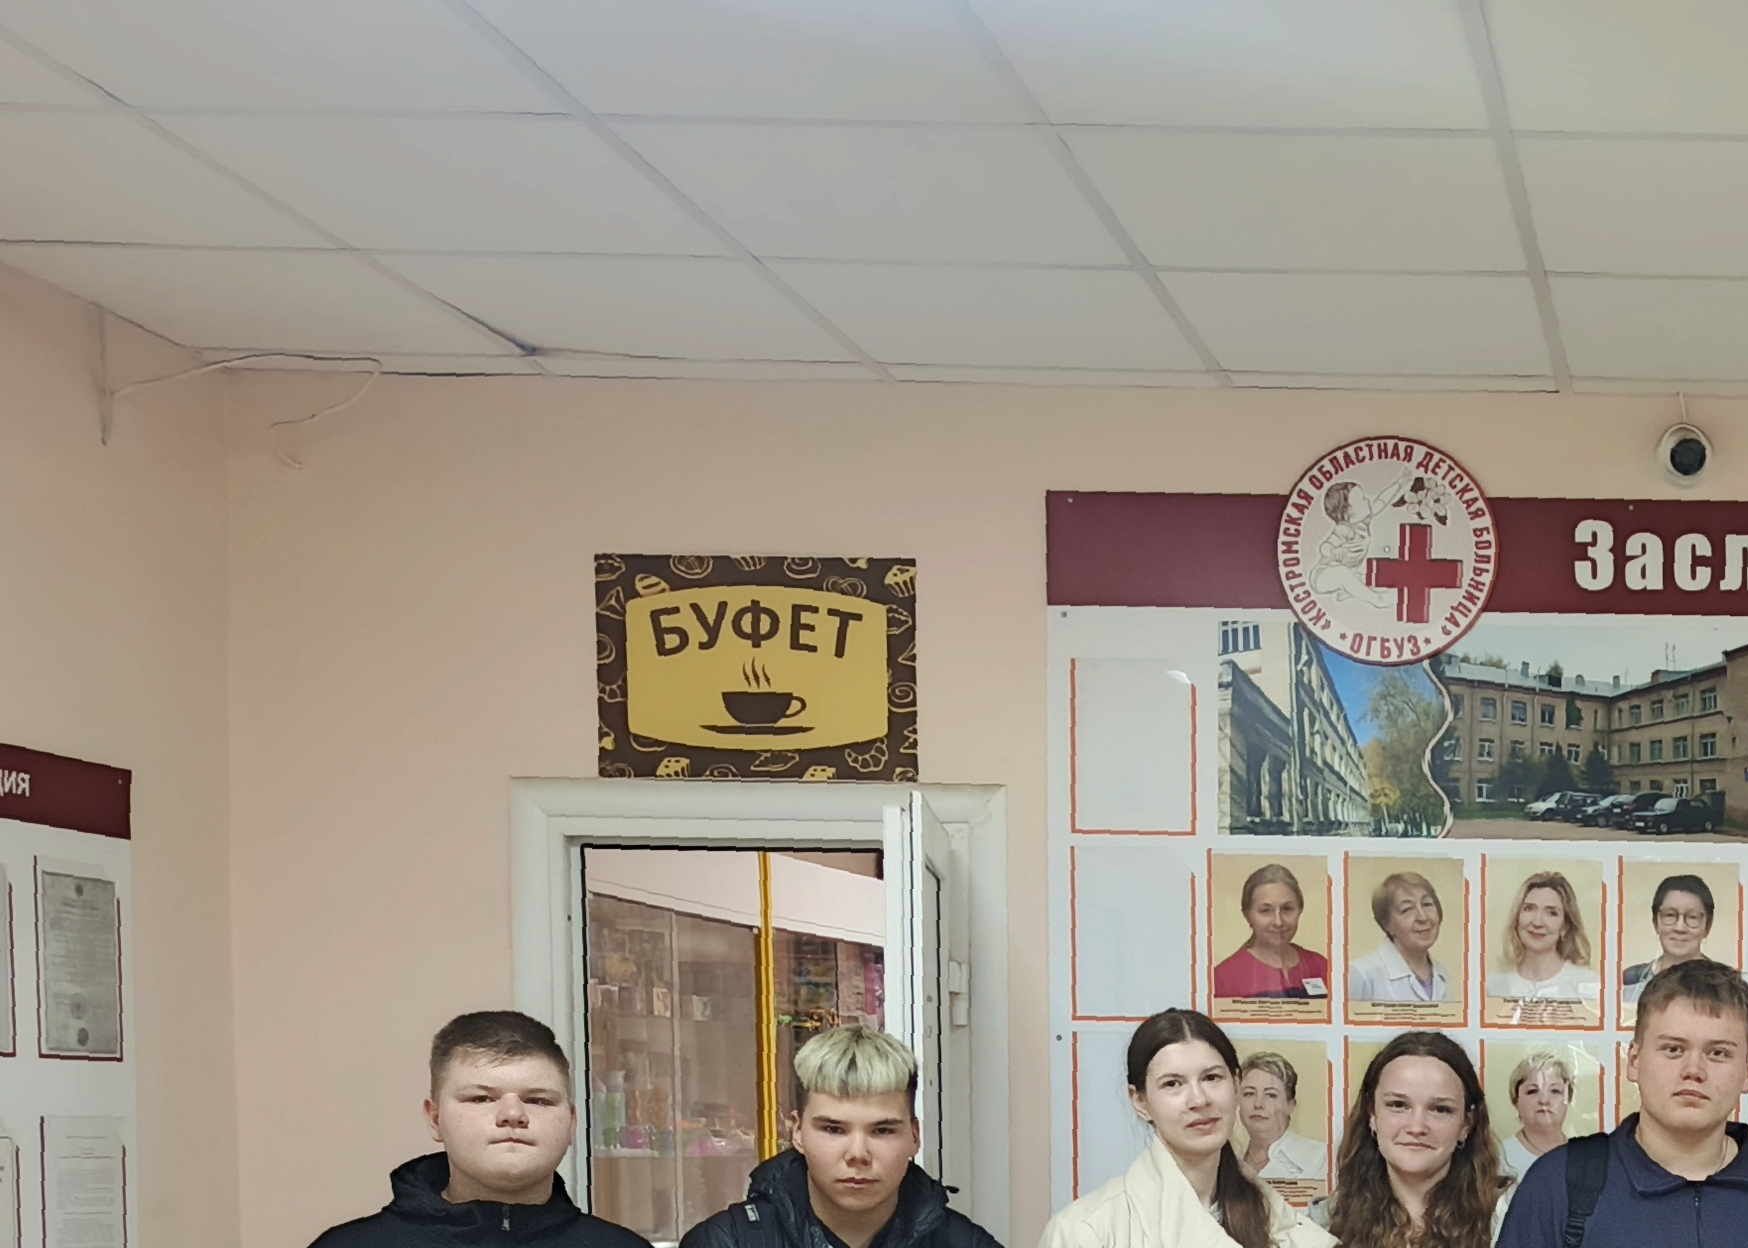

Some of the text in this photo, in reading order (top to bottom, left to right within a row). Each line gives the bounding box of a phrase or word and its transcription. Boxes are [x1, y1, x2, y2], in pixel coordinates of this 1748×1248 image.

[1308, 441, 1415, 491] ОБЛАСТНАЯ
[1415, 451, 1481, 520] ДЕТСКАЯ
[649, 599, 863, 659] БУФЕТ
[1350, 632, 1421, 659] ОГБУЗ
